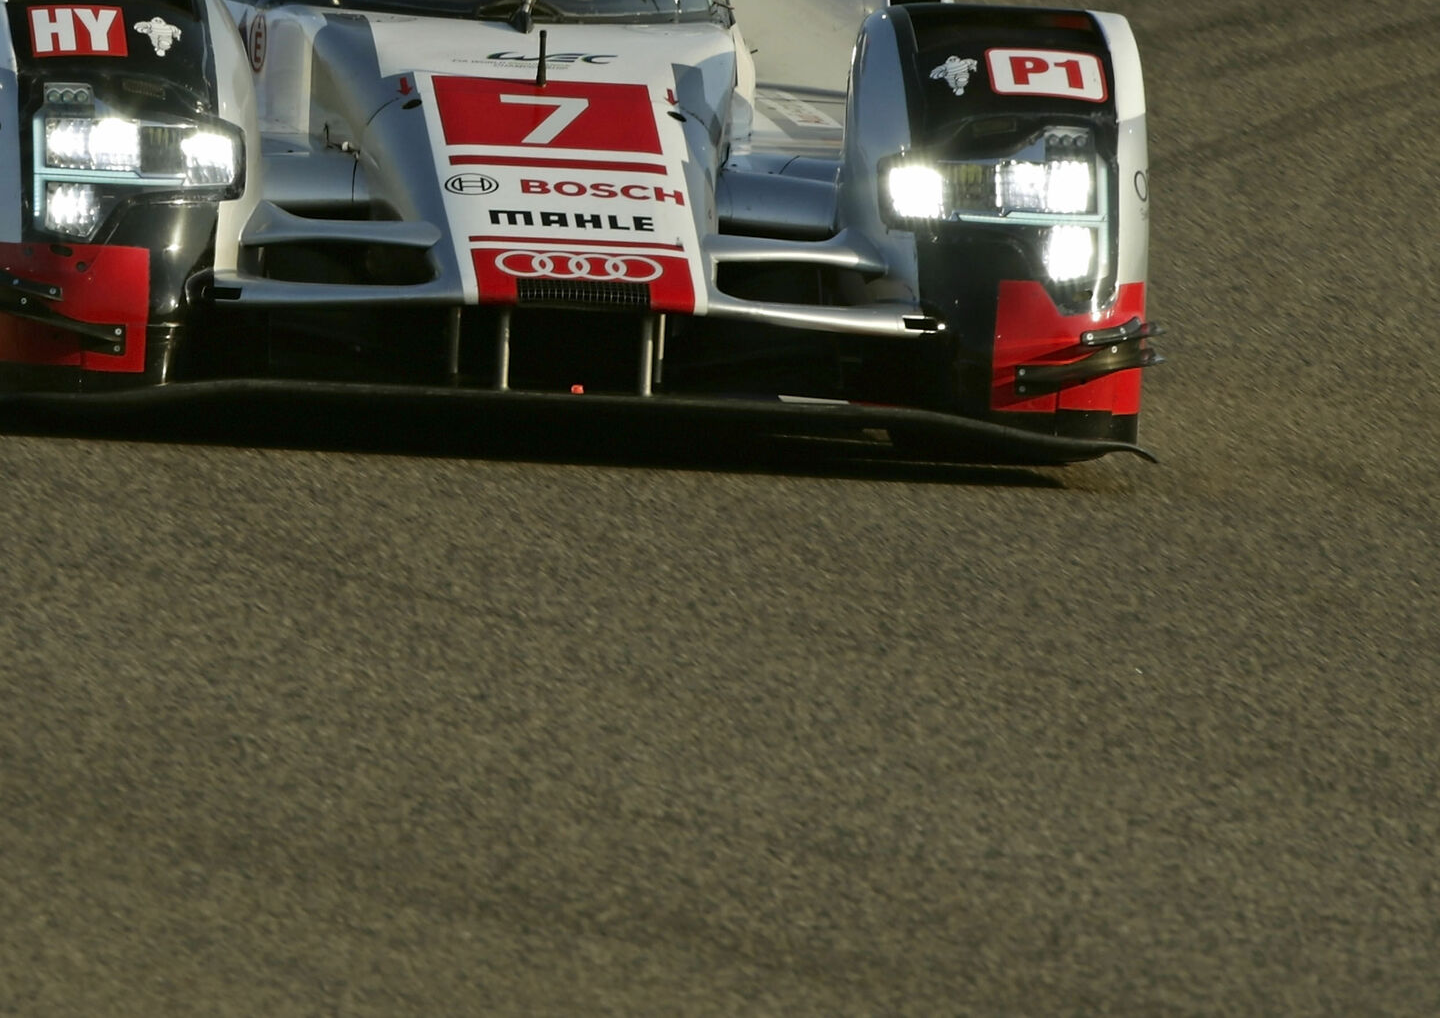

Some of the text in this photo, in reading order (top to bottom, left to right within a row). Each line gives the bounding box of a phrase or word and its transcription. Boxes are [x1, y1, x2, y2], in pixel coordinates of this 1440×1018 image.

[31, 8, 117, 52] HY
[1009, 56, 1084, 89] P1
[499, 93, 590, 144] 7
[520, 178, 685, 206] BOSCH
[489, 210, 654, 231] MAHLE
